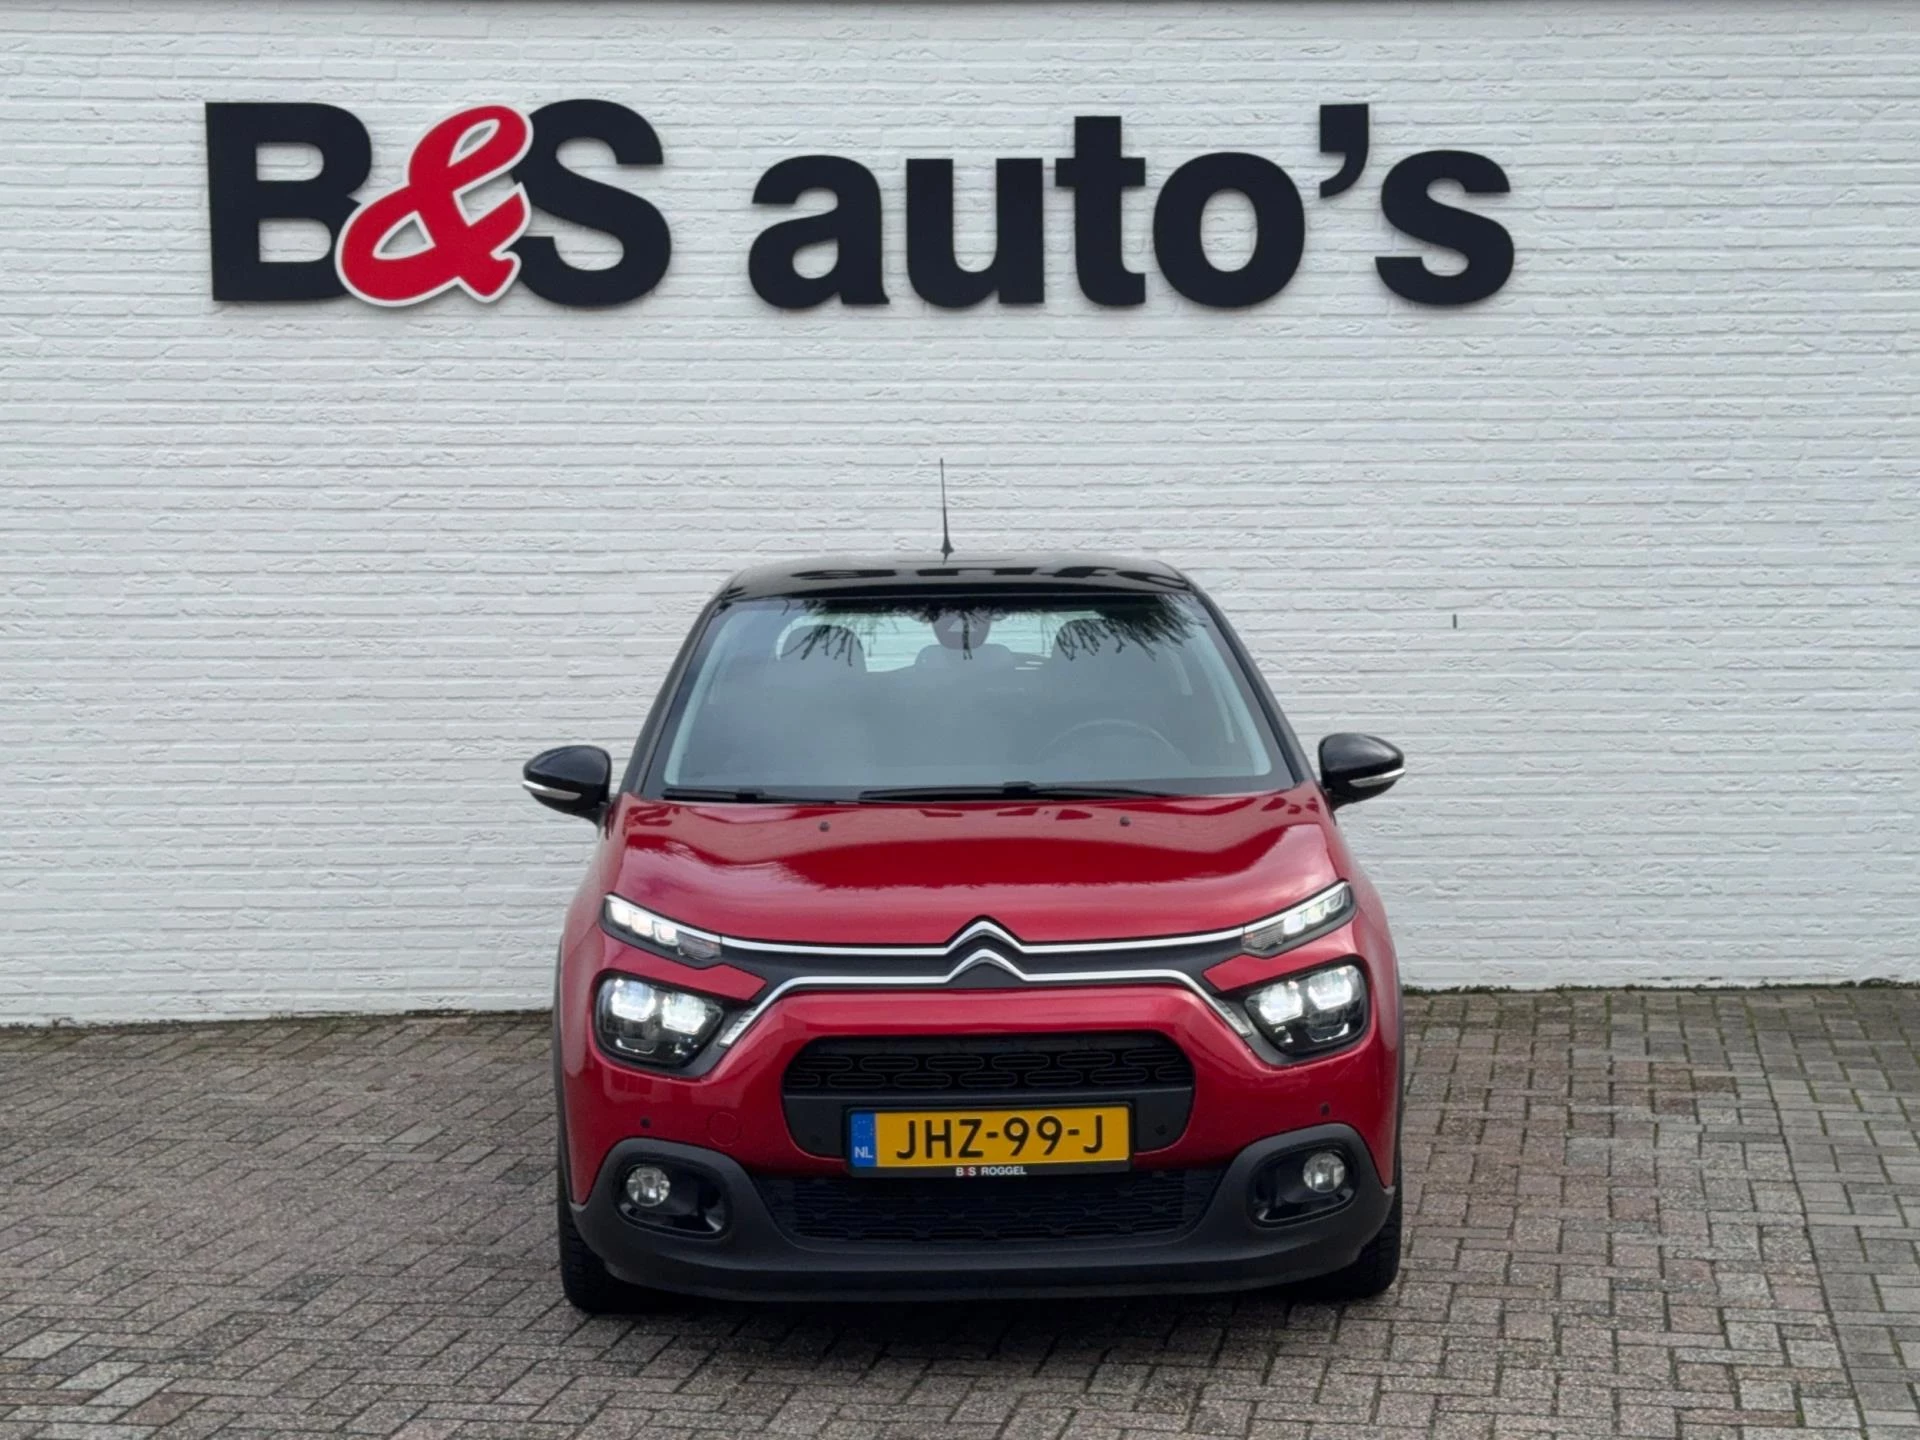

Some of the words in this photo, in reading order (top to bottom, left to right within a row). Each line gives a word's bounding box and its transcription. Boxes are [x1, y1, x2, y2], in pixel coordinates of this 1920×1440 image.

[205, 99, 671, 309] B&S
[749, 103, 1514, 310] auto's
[854, 1146, 873, 1158] NL
[896, 1114, 1104, 1160] JHZ-99-J
[981, 1166, 1027, 1176] ROGGEL
